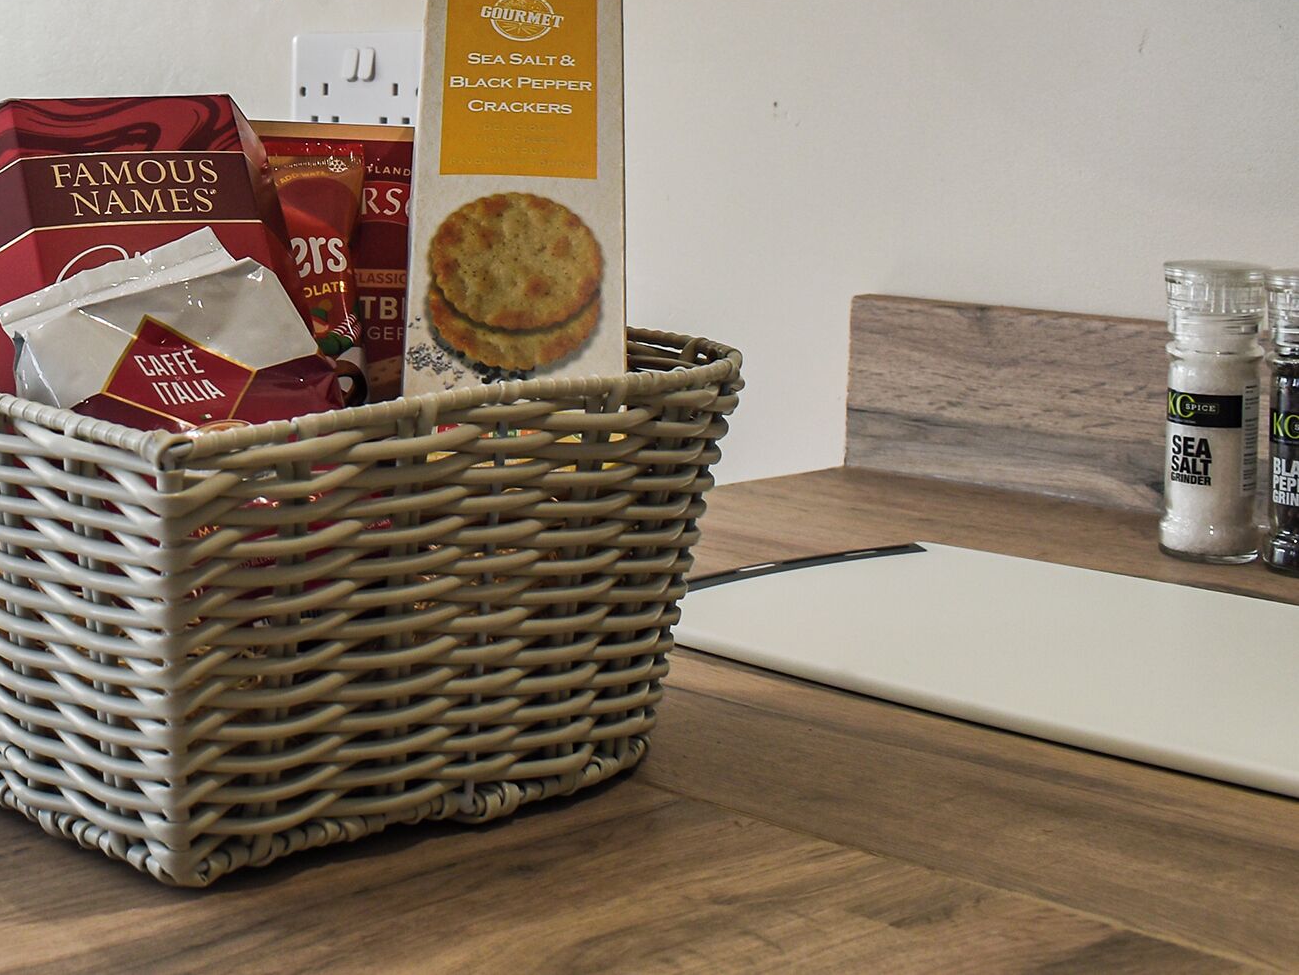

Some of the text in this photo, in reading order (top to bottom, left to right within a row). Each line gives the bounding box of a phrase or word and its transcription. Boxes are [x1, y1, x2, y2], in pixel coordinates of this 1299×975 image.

[480, 5, 564, 28] GOURMET
[467, 52, 576, 66] SEA SALT &
[449, 76, 592, 91] BLACK PEPPER
[467, 99, 573, 114] CRACKERS
[50, 159, 219, 188] FAMOUS
[366, 166, 411, 177] TLAND
[70, 187, 214, 216] NAMES
[290, 236, 348, 278] ers
[357, 272, 407, 285] LASSIC
[303, 280, 347, 298] OLATE
[152, 379, 226, 405] ITALIA
[1185, 402, 1217, 413] SPICE
[1171, 434, 1212, 459] SEA
[1171, 455, 1212, 476] SALT
[1273, 456, 1299, 478] BLA
[1170, 472, 1212, 486] GRINDER
[1272, 489, 1299, 507] GRIN
